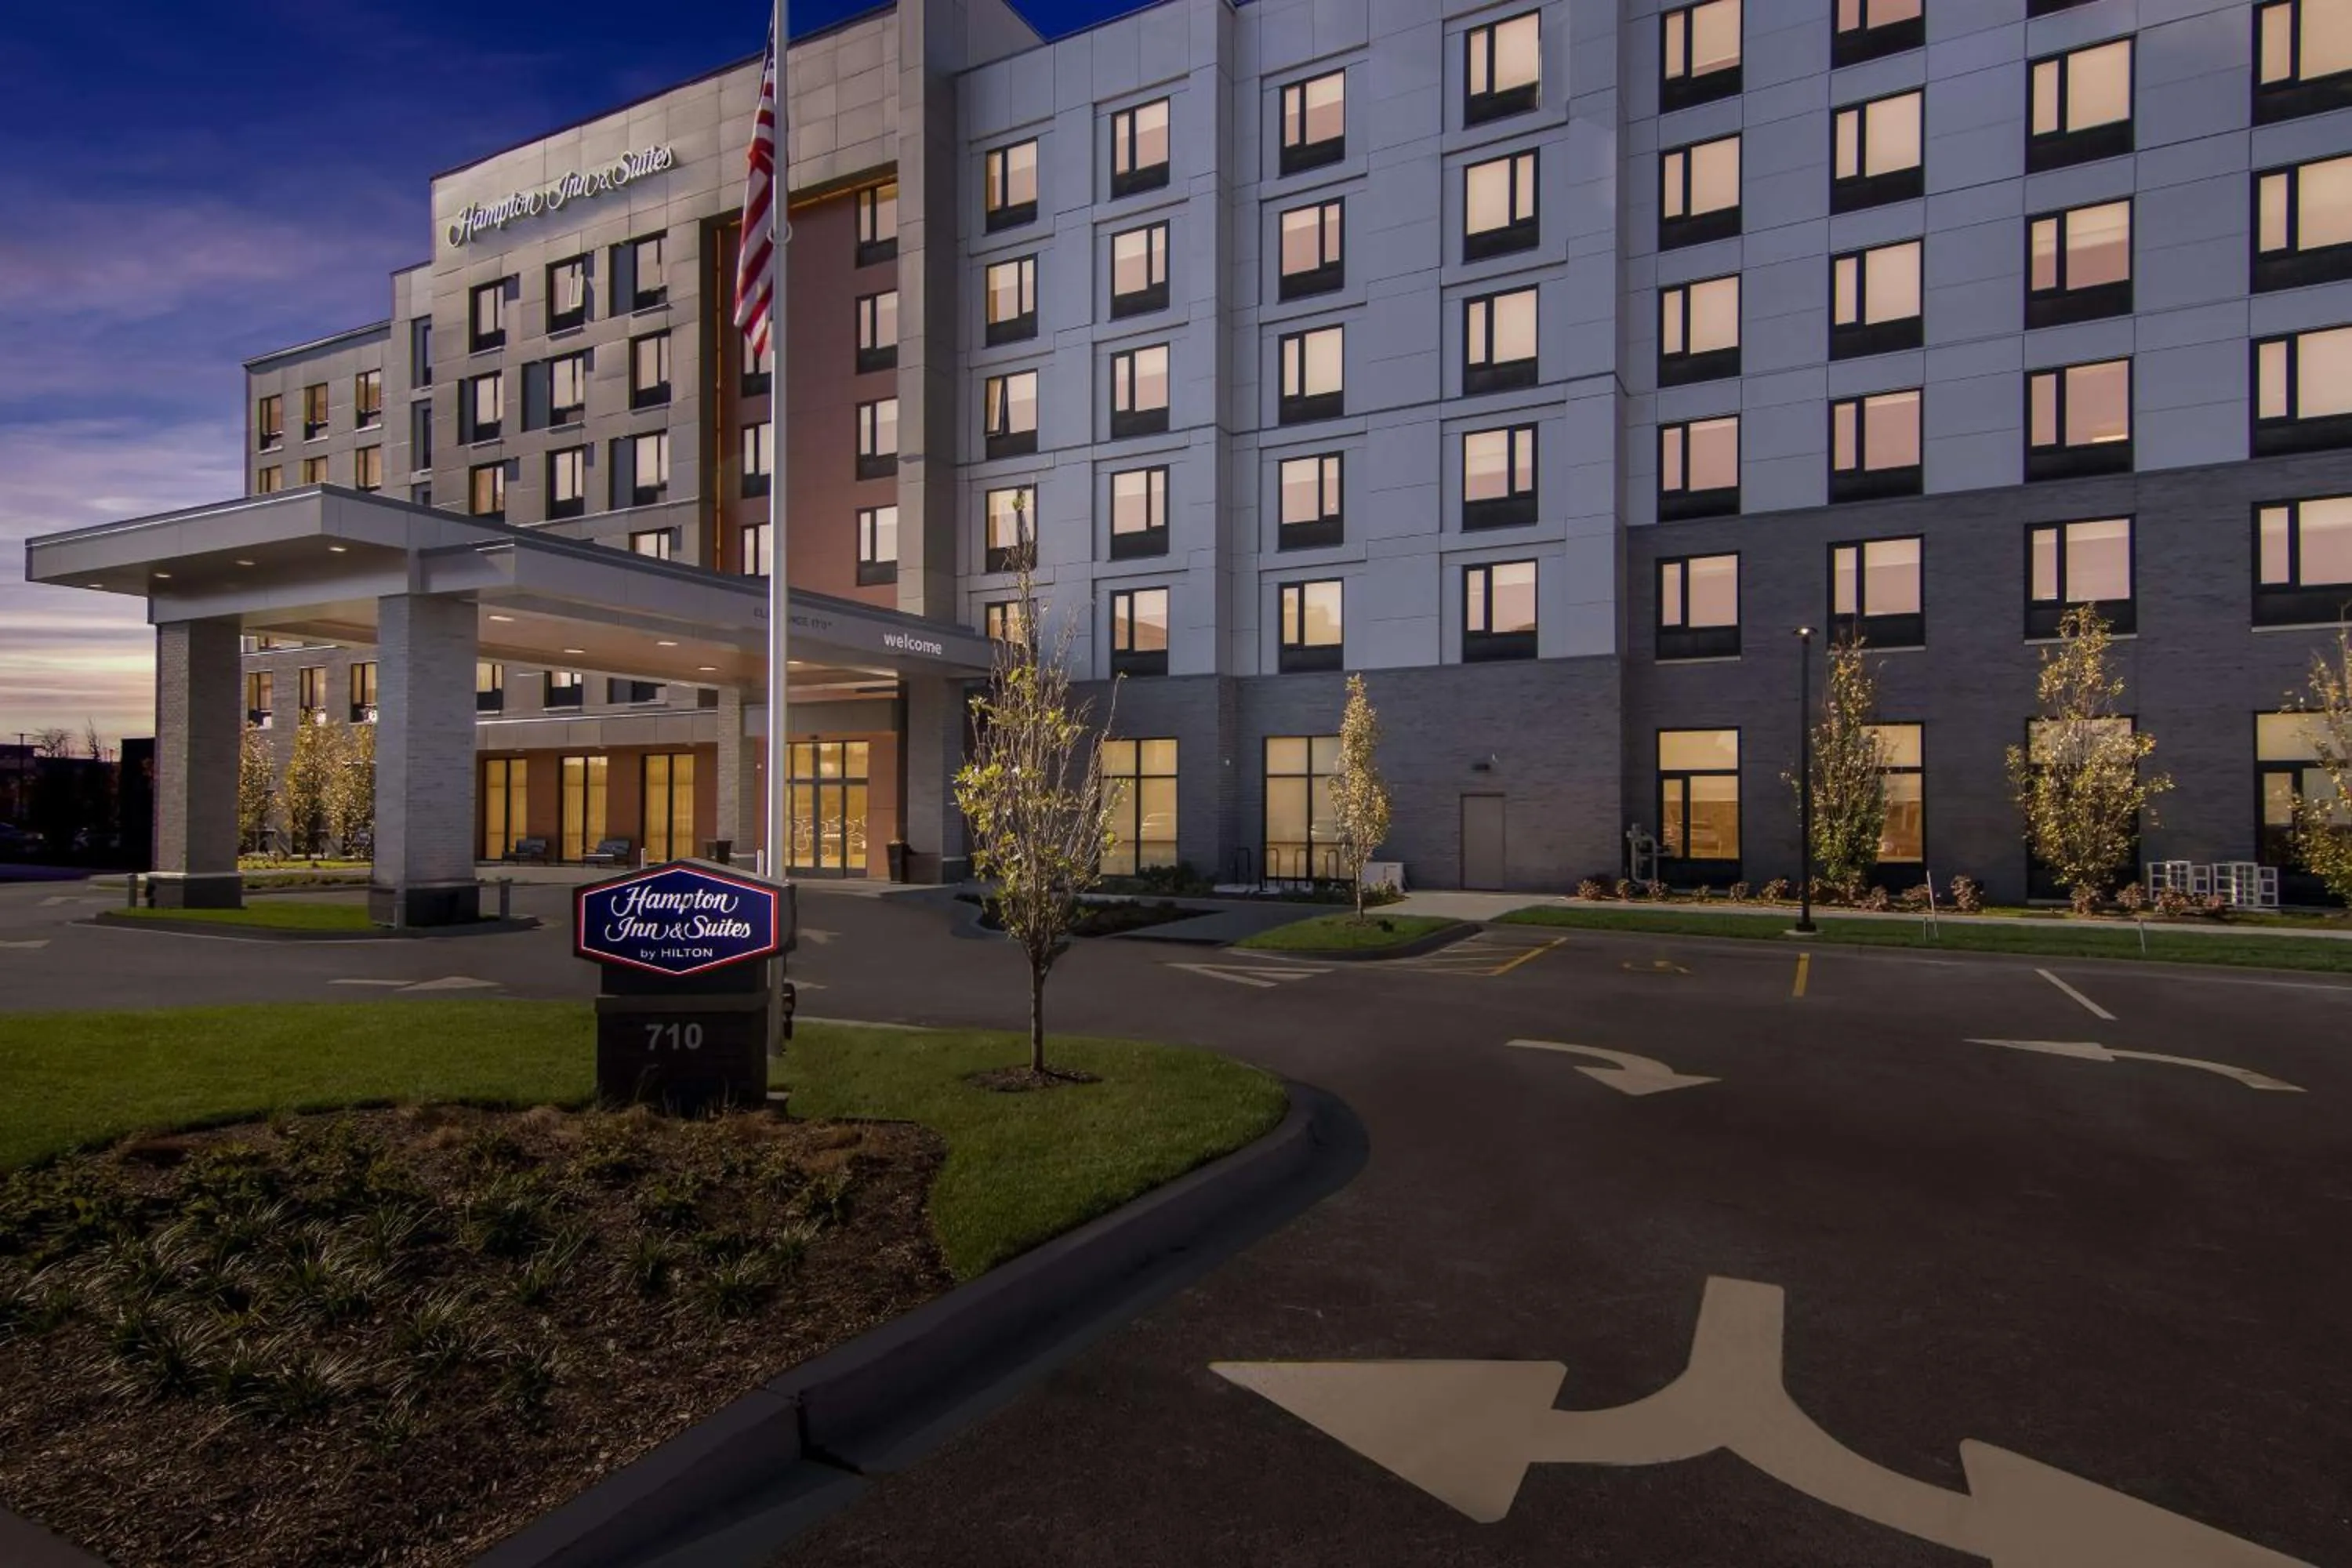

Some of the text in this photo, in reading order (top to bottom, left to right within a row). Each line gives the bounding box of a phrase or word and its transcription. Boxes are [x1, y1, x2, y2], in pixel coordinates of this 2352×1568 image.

[448, 143, 673, 247] Hampton Inn & Suites
[883, 632, 942, 655] welcome
[611, 885, 739, 916] Hampton
[604, 915, 751, 942] Inn & Suites
[640, 948, 713, 960] by HILTON
[644, 1022, 705, 1051] 710
